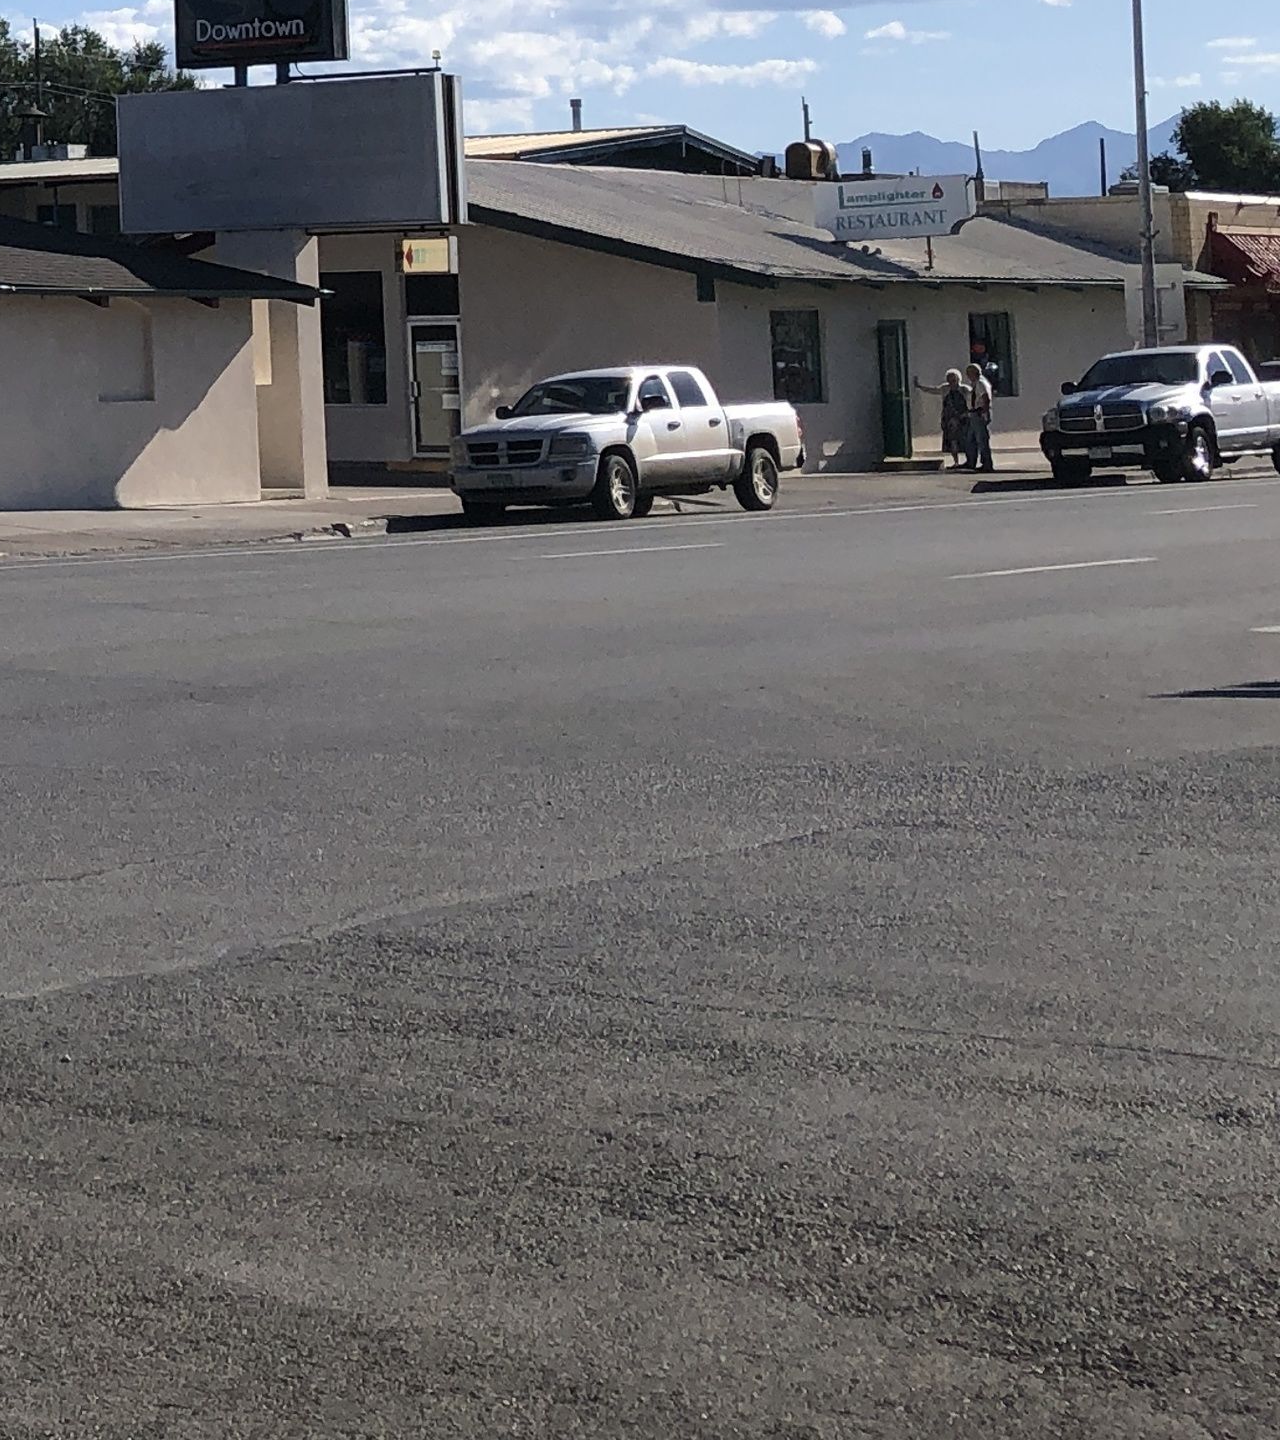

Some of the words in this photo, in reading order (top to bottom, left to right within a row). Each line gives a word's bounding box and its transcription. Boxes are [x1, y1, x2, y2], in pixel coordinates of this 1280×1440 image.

[197, 17, 304, 42] Downtown
[838, 186, 928, 209] Lamplighter
[835, 209, 948, 231] RESTAURANT
